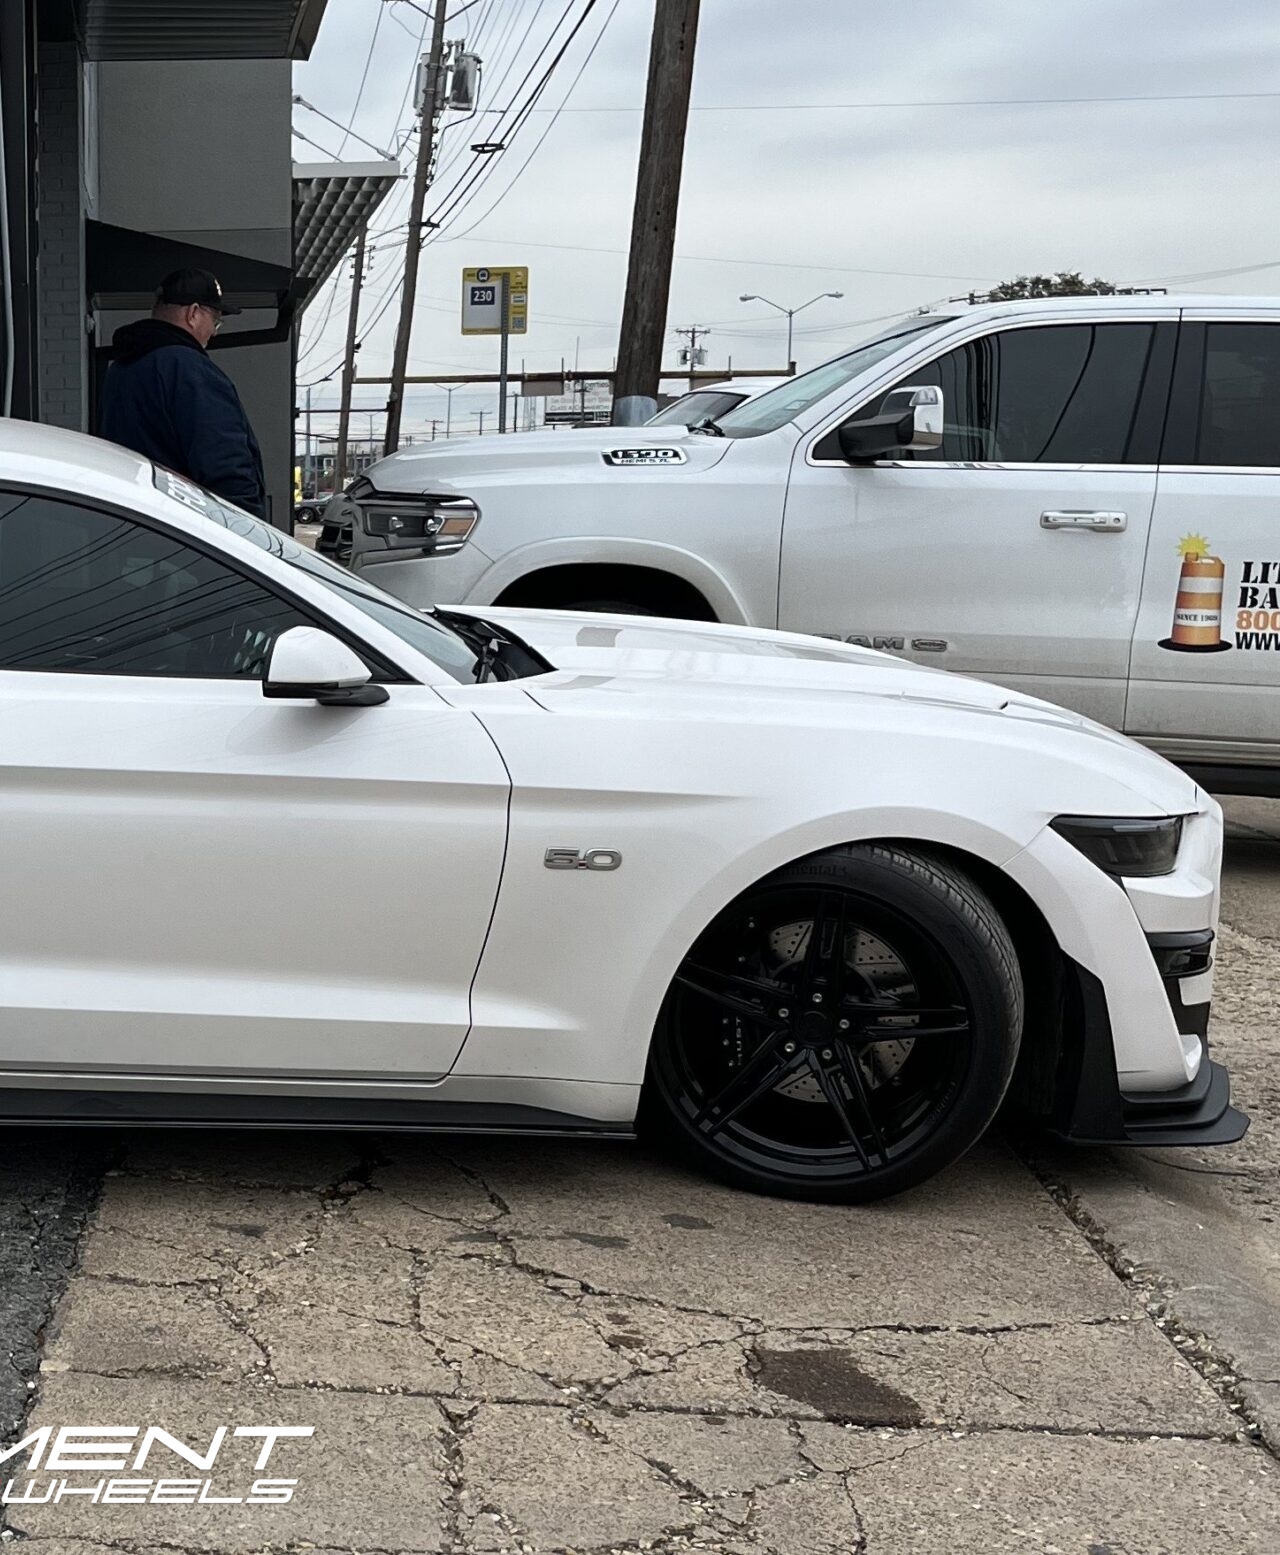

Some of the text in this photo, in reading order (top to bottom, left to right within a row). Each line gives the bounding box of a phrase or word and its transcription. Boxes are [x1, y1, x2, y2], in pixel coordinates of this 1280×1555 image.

[473, 290, 493, 302] 230
[617, 450, 674, 459] 1500
[543, 847, 622, 871] 5.0
